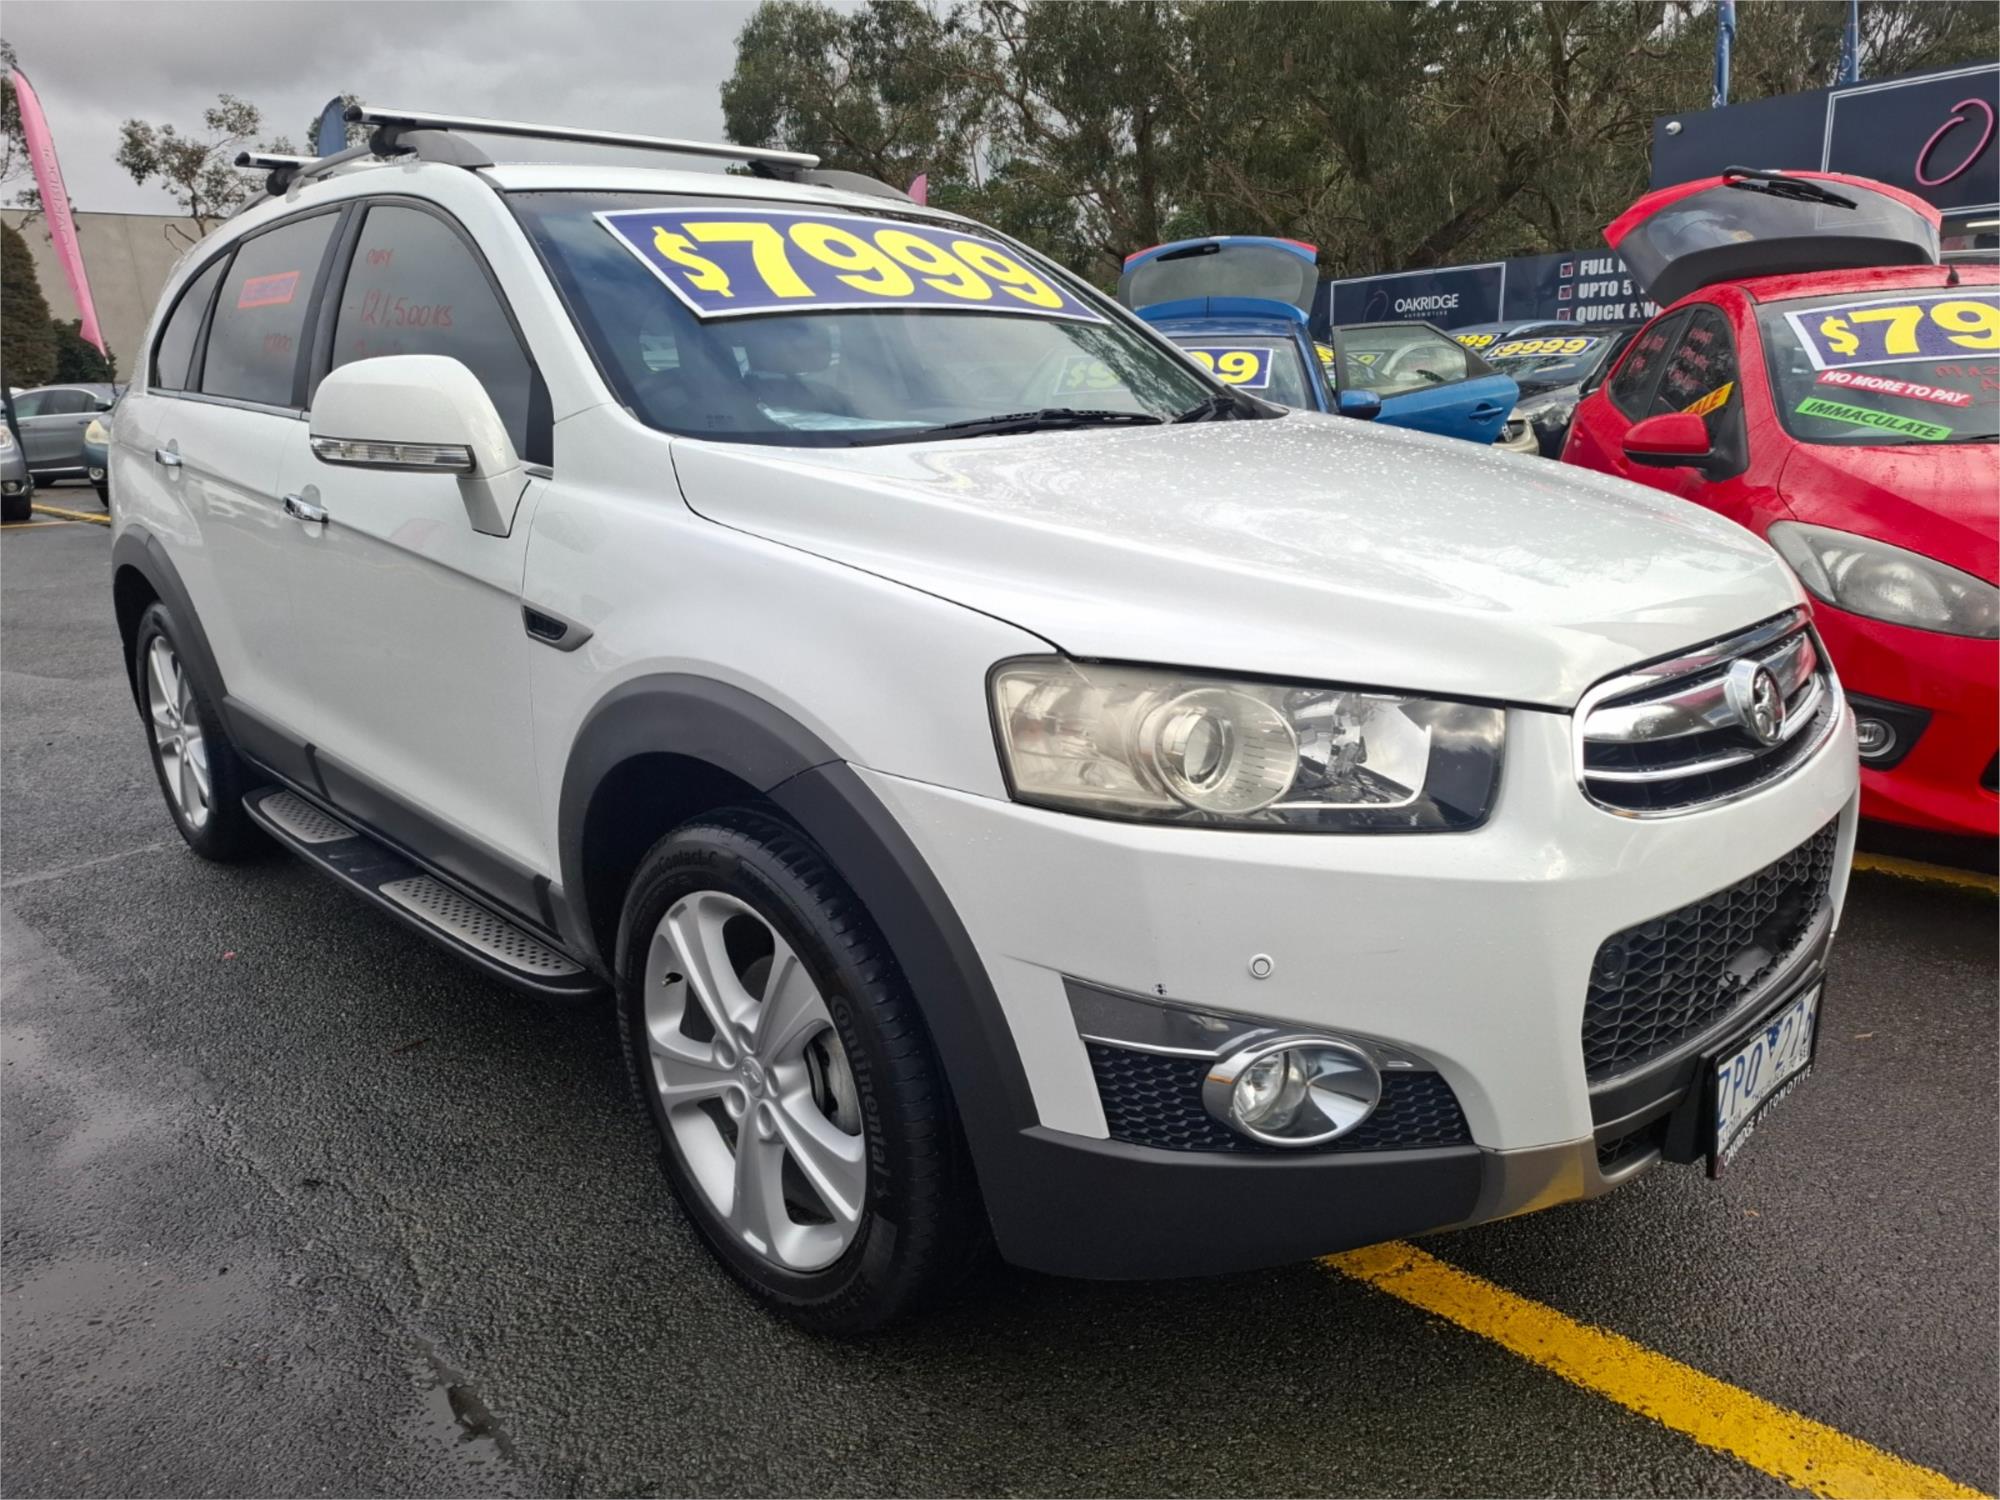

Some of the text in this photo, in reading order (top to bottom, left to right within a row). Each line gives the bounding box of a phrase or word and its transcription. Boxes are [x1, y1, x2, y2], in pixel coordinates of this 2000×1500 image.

[652, 222, 1064, 309] $7999
[1579, 257, 1614, 276] FULL
[1394, 292, 1460, 313] OAKRIDGE
[1578, 280, 1619, 299] UPTO
[1622, 279, 1633, 296] 5
[1575, 303, 1626, 323] QUICK
[1822, 370, 1970, 404] NO MORE TO PAY
[1804, 401, 1943, 438] IMMACULATE
[1757, 1063, 1813, 1123] AUTOMOTIVE
